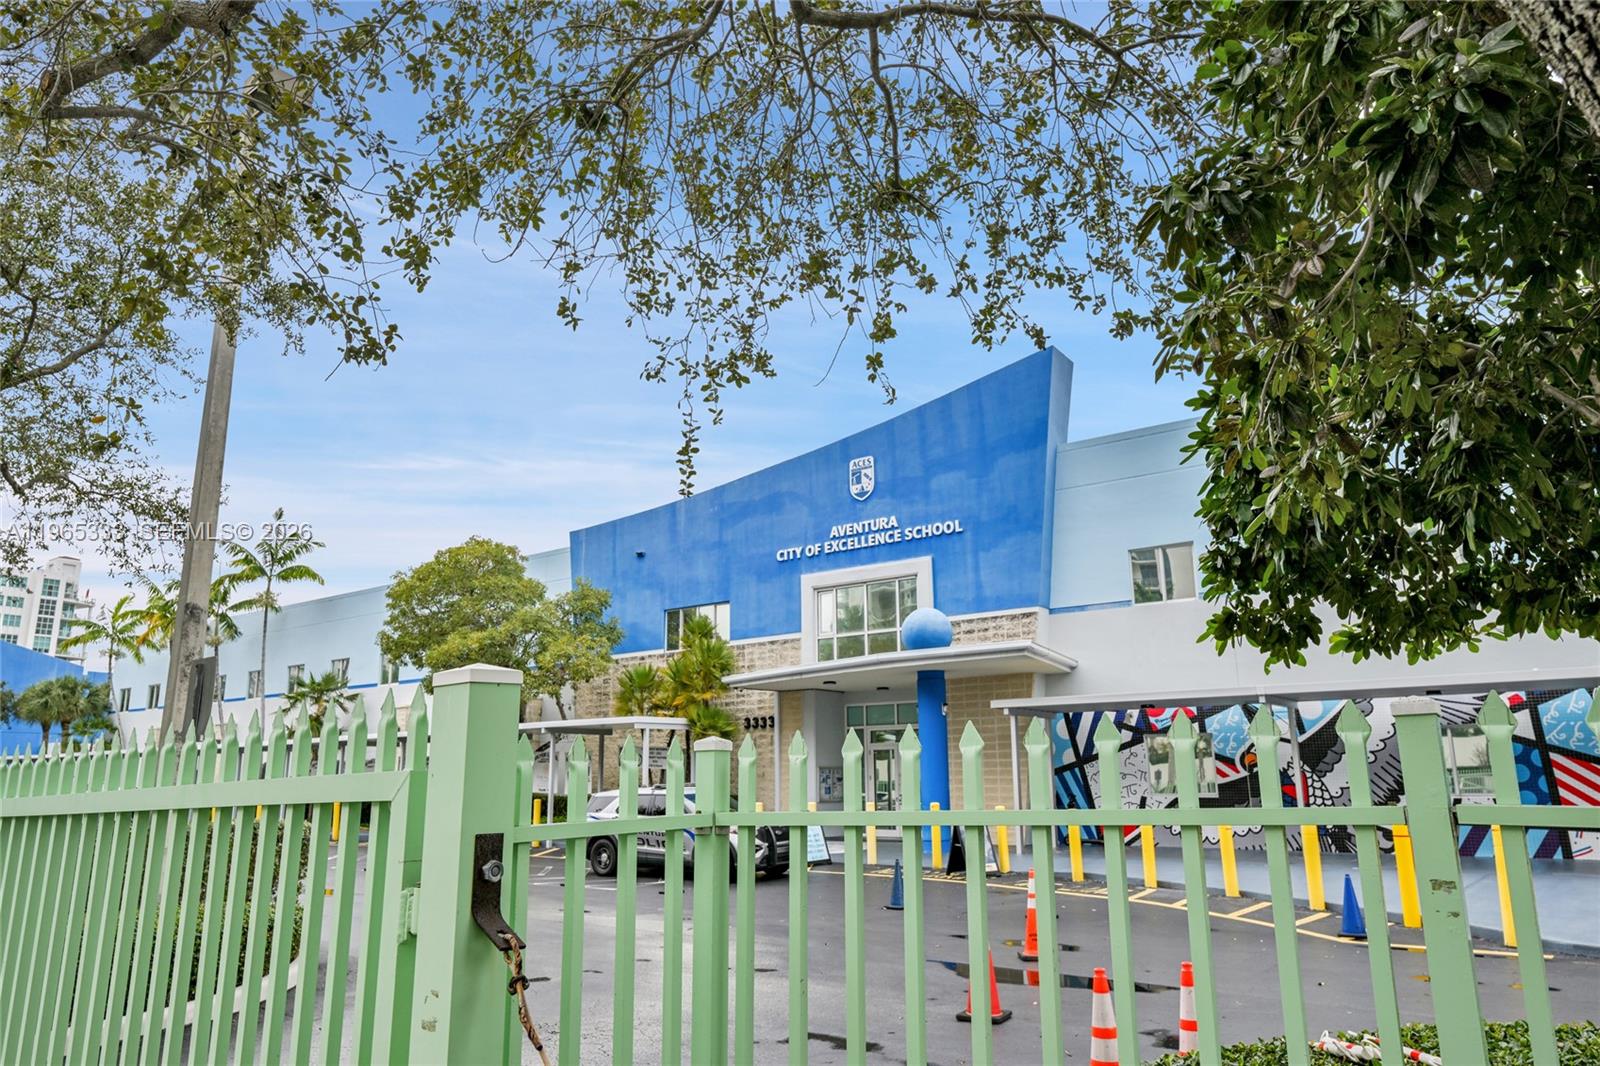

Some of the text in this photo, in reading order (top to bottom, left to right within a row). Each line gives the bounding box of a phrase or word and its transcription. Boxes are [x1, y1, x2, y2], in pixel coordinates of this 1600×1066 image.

[851, 457, 872, 469] ACES
[829, 515, 899, 538] AVENTURA
[776, 519, 964, 561] CITY OF EXCELLENCE SCHOOL
[743, 715, 775, 730] 3333
